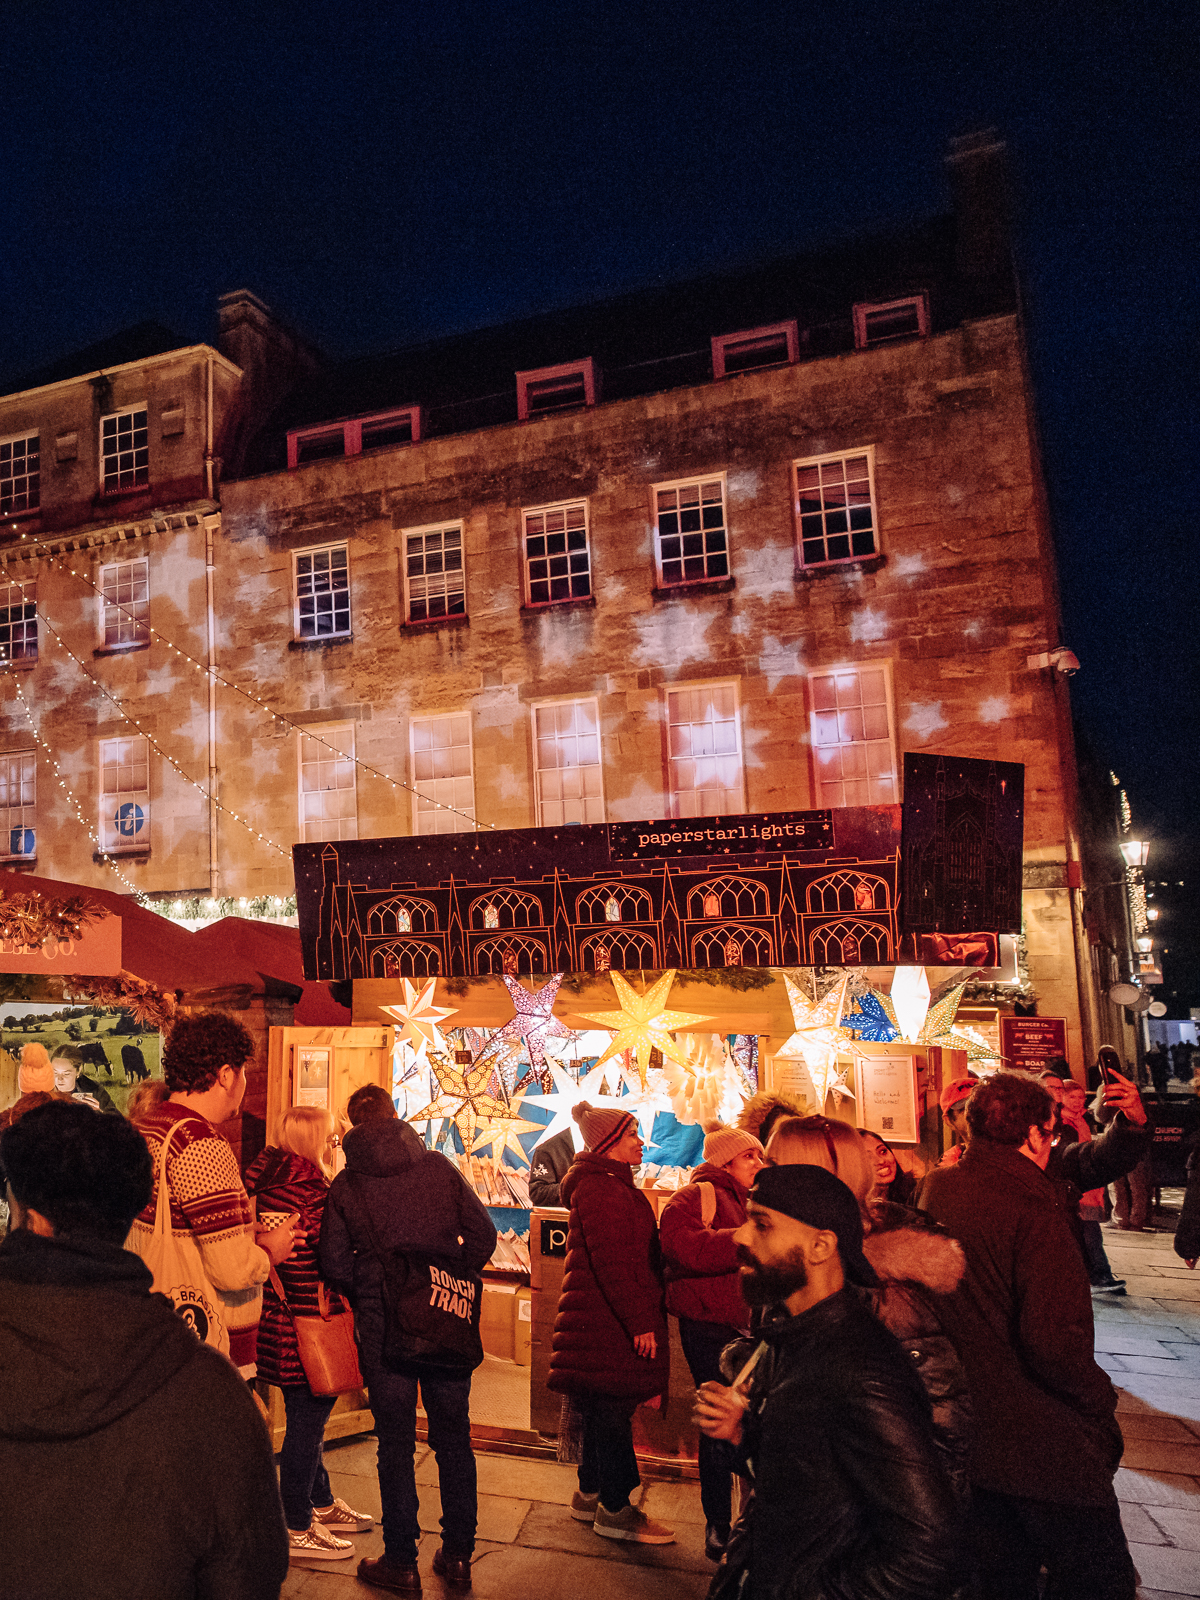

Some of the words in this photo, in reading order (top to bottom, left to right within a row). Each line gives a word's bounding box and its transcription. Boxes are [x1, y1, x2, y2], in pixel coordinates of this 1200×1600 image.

[638, 823, 806, 847] paperstarlights
[429, 1265, 476, 1303] ROUGH
[429, 1283, 473, 1325] TRADE
